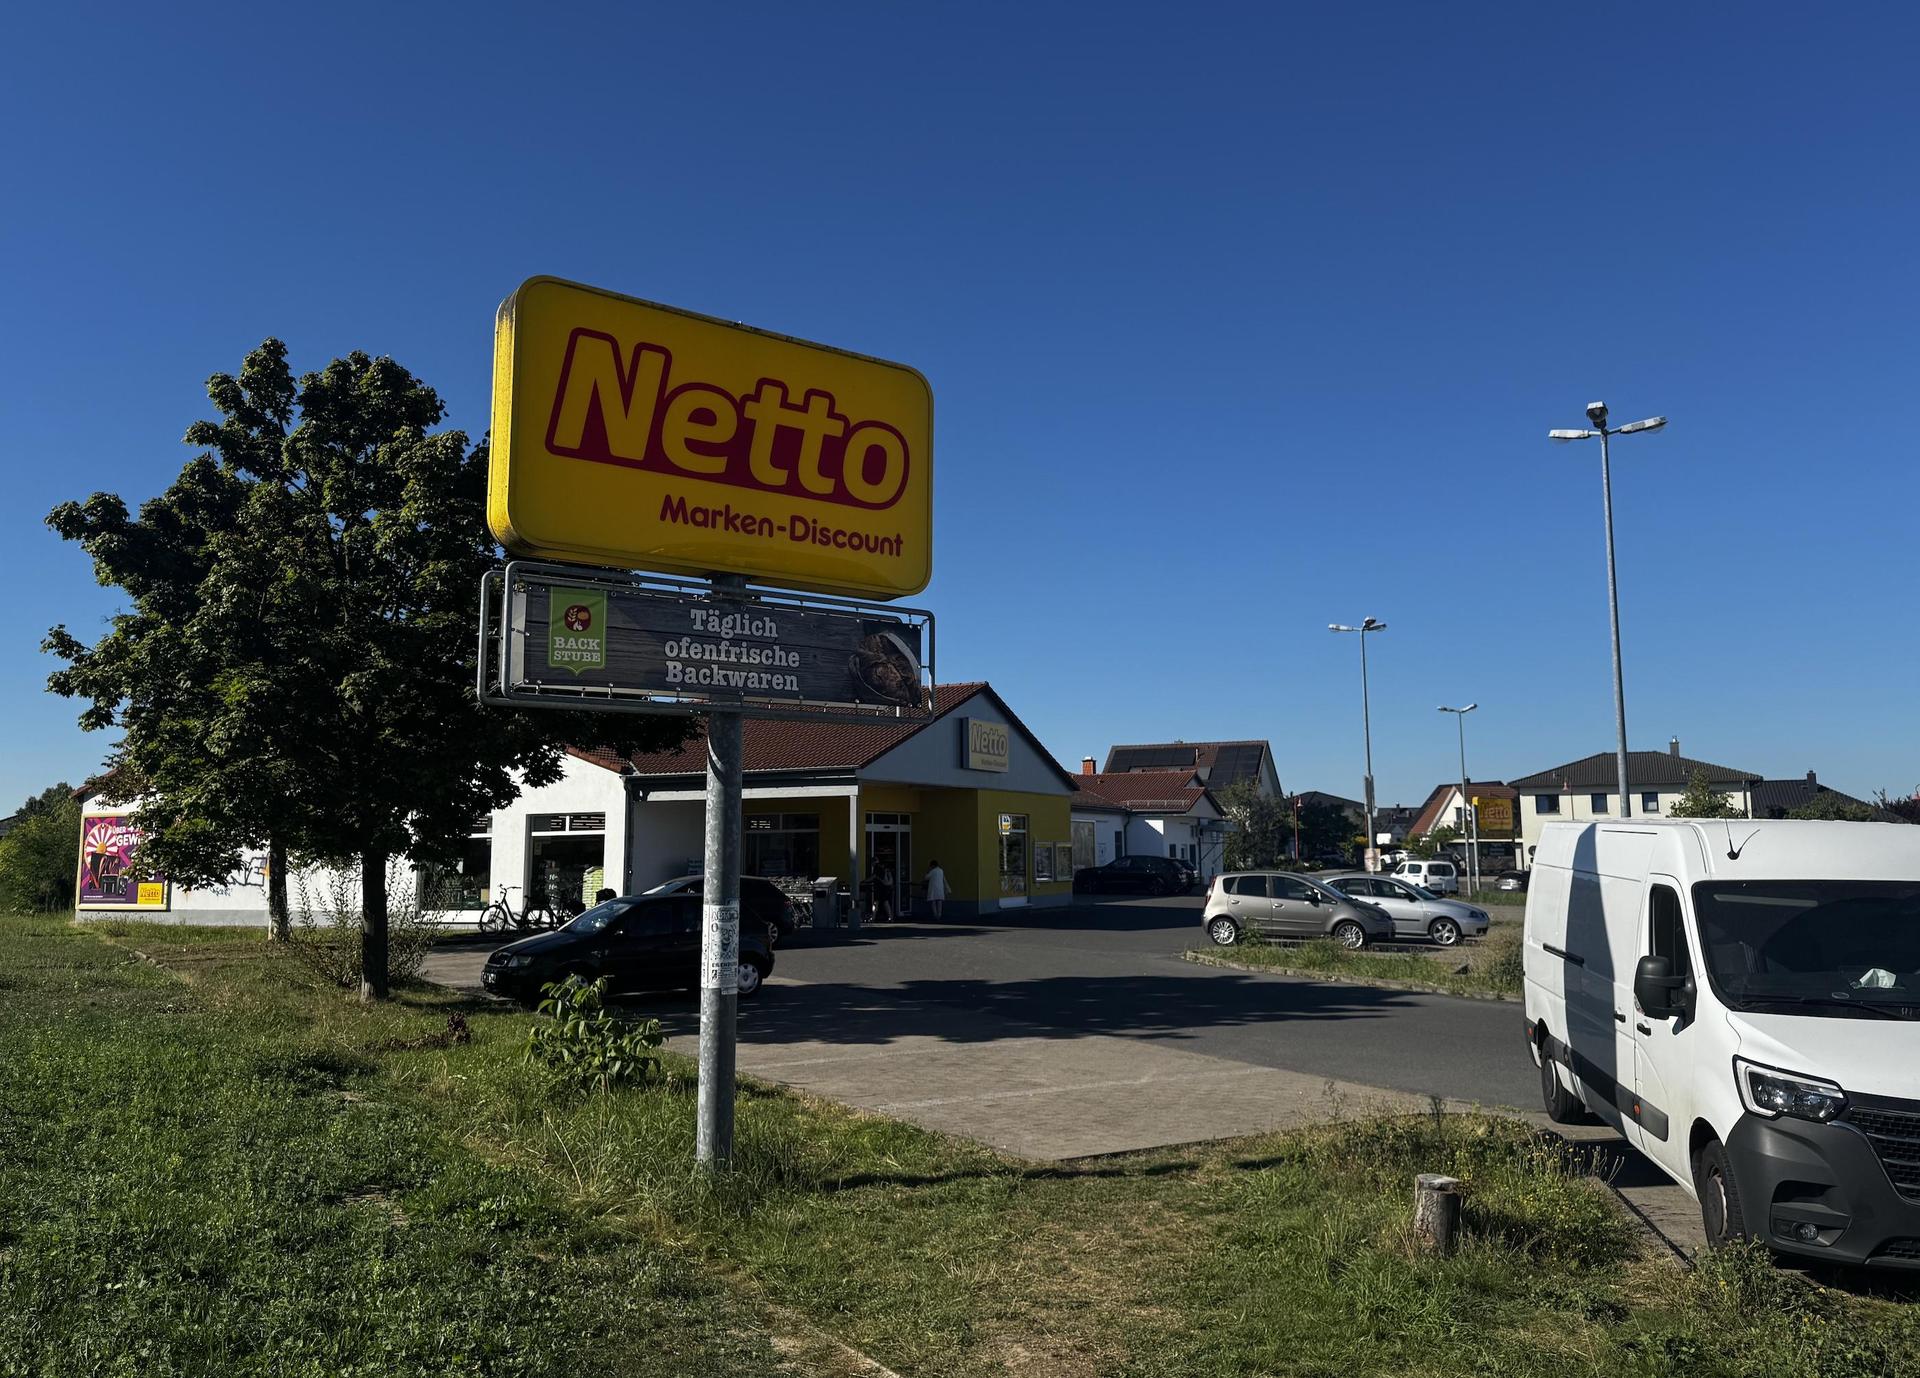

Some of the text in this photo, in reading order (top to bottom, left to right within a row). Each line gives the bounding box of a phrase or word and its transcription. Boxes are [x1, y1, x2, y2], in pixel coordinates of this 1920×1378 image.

[545, 327, 910, 510] Netto
[660, 494, 904, 558] Marken-Discount
[690, 609, 778, 640] Täglich
[553, 636, 601, 651] BACK
[553, 650, 601, 663] STUBE
[664, 639, 800, 668] ofenfrische
[665, 662, 799, 692] Backwaren
[971, 722, 1008, 757] Netto
[140, 887, 161, 898] Netto
